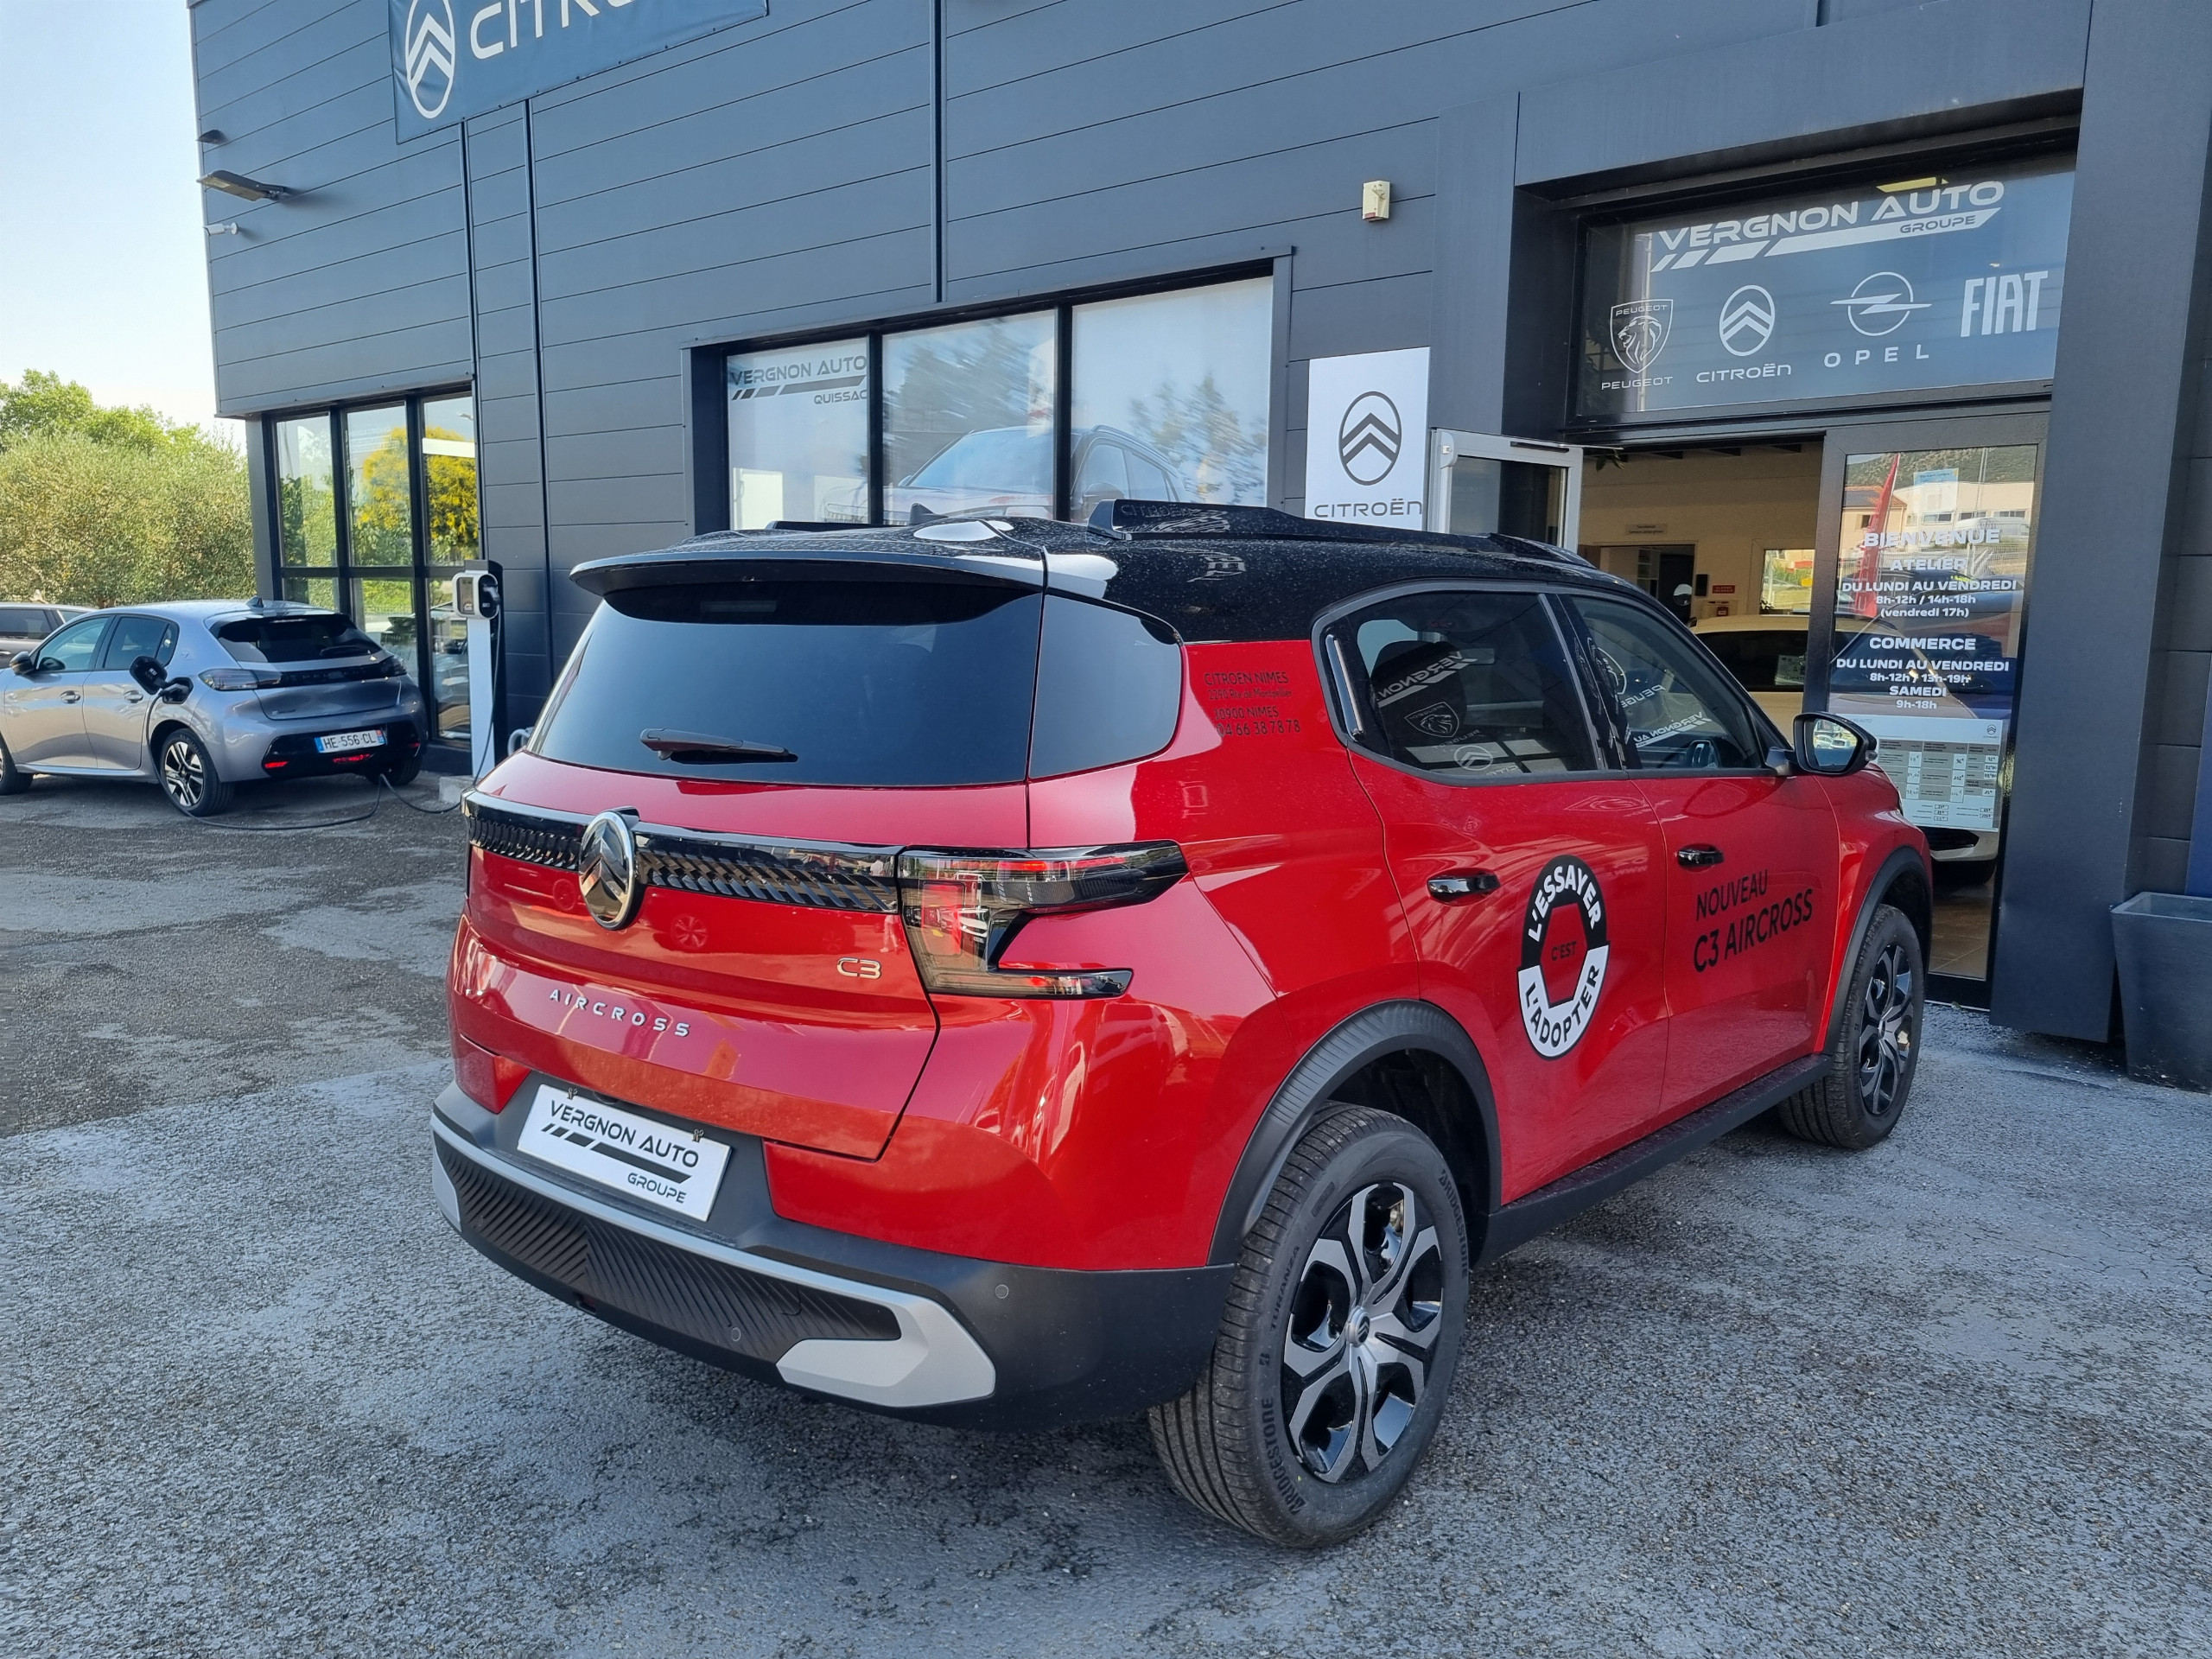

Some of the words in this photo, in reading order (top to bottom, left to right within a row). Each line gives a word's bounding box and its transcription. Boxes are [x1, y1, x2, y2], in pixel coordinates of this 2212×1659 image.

[1658, 201, 1859, 251] VERGNON
[1870, 180, 2005, 222] AUTO
[1899, 214, 1977, 235] GROUPE
[1615, 304, 1669, 317] PEUGEOT
[1960, 270, 2048, 338] FIAT
[1823, 344, 1929, 368] OPEL
[730, 362, 811, 385] VERGNON
[817, 355, 867, 376] AUTO
[1600, 376, 1674, 391] PEUGEOT
[813, 389, 868, 405] QUISSAC
[1864, 528, 2000, 547] BIENVENUE
[1890, 558, 1967, 571] ATELIER
[1841, 582, 1863, 592] DU
[1866, 581, 1909, 592] LUNDI
[1911, 581, 1936, 591] AU
[1936, 580, 2017, 591] VENDREDI
[1876, 595, 1916, 605] 8h-12h
[1927, 595, 1977, 604] 14h-18h
[1880, 607, 1940, 619] (vendredi
[1942, 607, 1970, 618] 17h)
[1869, 637, 1977, 651] COMMERCE
[1836, 658, 1857, 669] DU
[1859, 658, 1903, 669] LUNDI
[1904, 659, 1928, 670] AU
[1931, 660, 2010, 671] VENDREDI
[1869, 672, 1910, 683] 8h-12h
[1921, 673, 1969, 683] 13h-19h
[1889, 685, 1948, 696] SAMEDI
[1214, 707, 1244, 721] 30900
[1247, 706, 1279, 719] NIMES
[1896, 700, 1938, 709] 9h-18h
[1236, 722, 1250, 736] 66
[1253, 721, 1268, 735] 38
[1269, 720, 1285, 734] 78
[1286, 719, 1301, 734] 78
[1528, 864, 1602, 943] L'ESSAYER
[1695, 868, 1769, 922] NOUVEAU
[1693, 928, 1719, 973] C3
[1725, 888, 1814, 961] AIRCROSS
[1550, 939, 1577, 962] C'EST
[836, 957, 882, 979] C3
[549, 988, 690, 1038] AIRCROSS
[1524, 964, 1600, 1048] L'ADOPTER
[548, 1099, 637, 1147] VERGNON
[638, 1134, 700, 1169] AUTO
[626, 1171, 688, 1205] GROUPE
